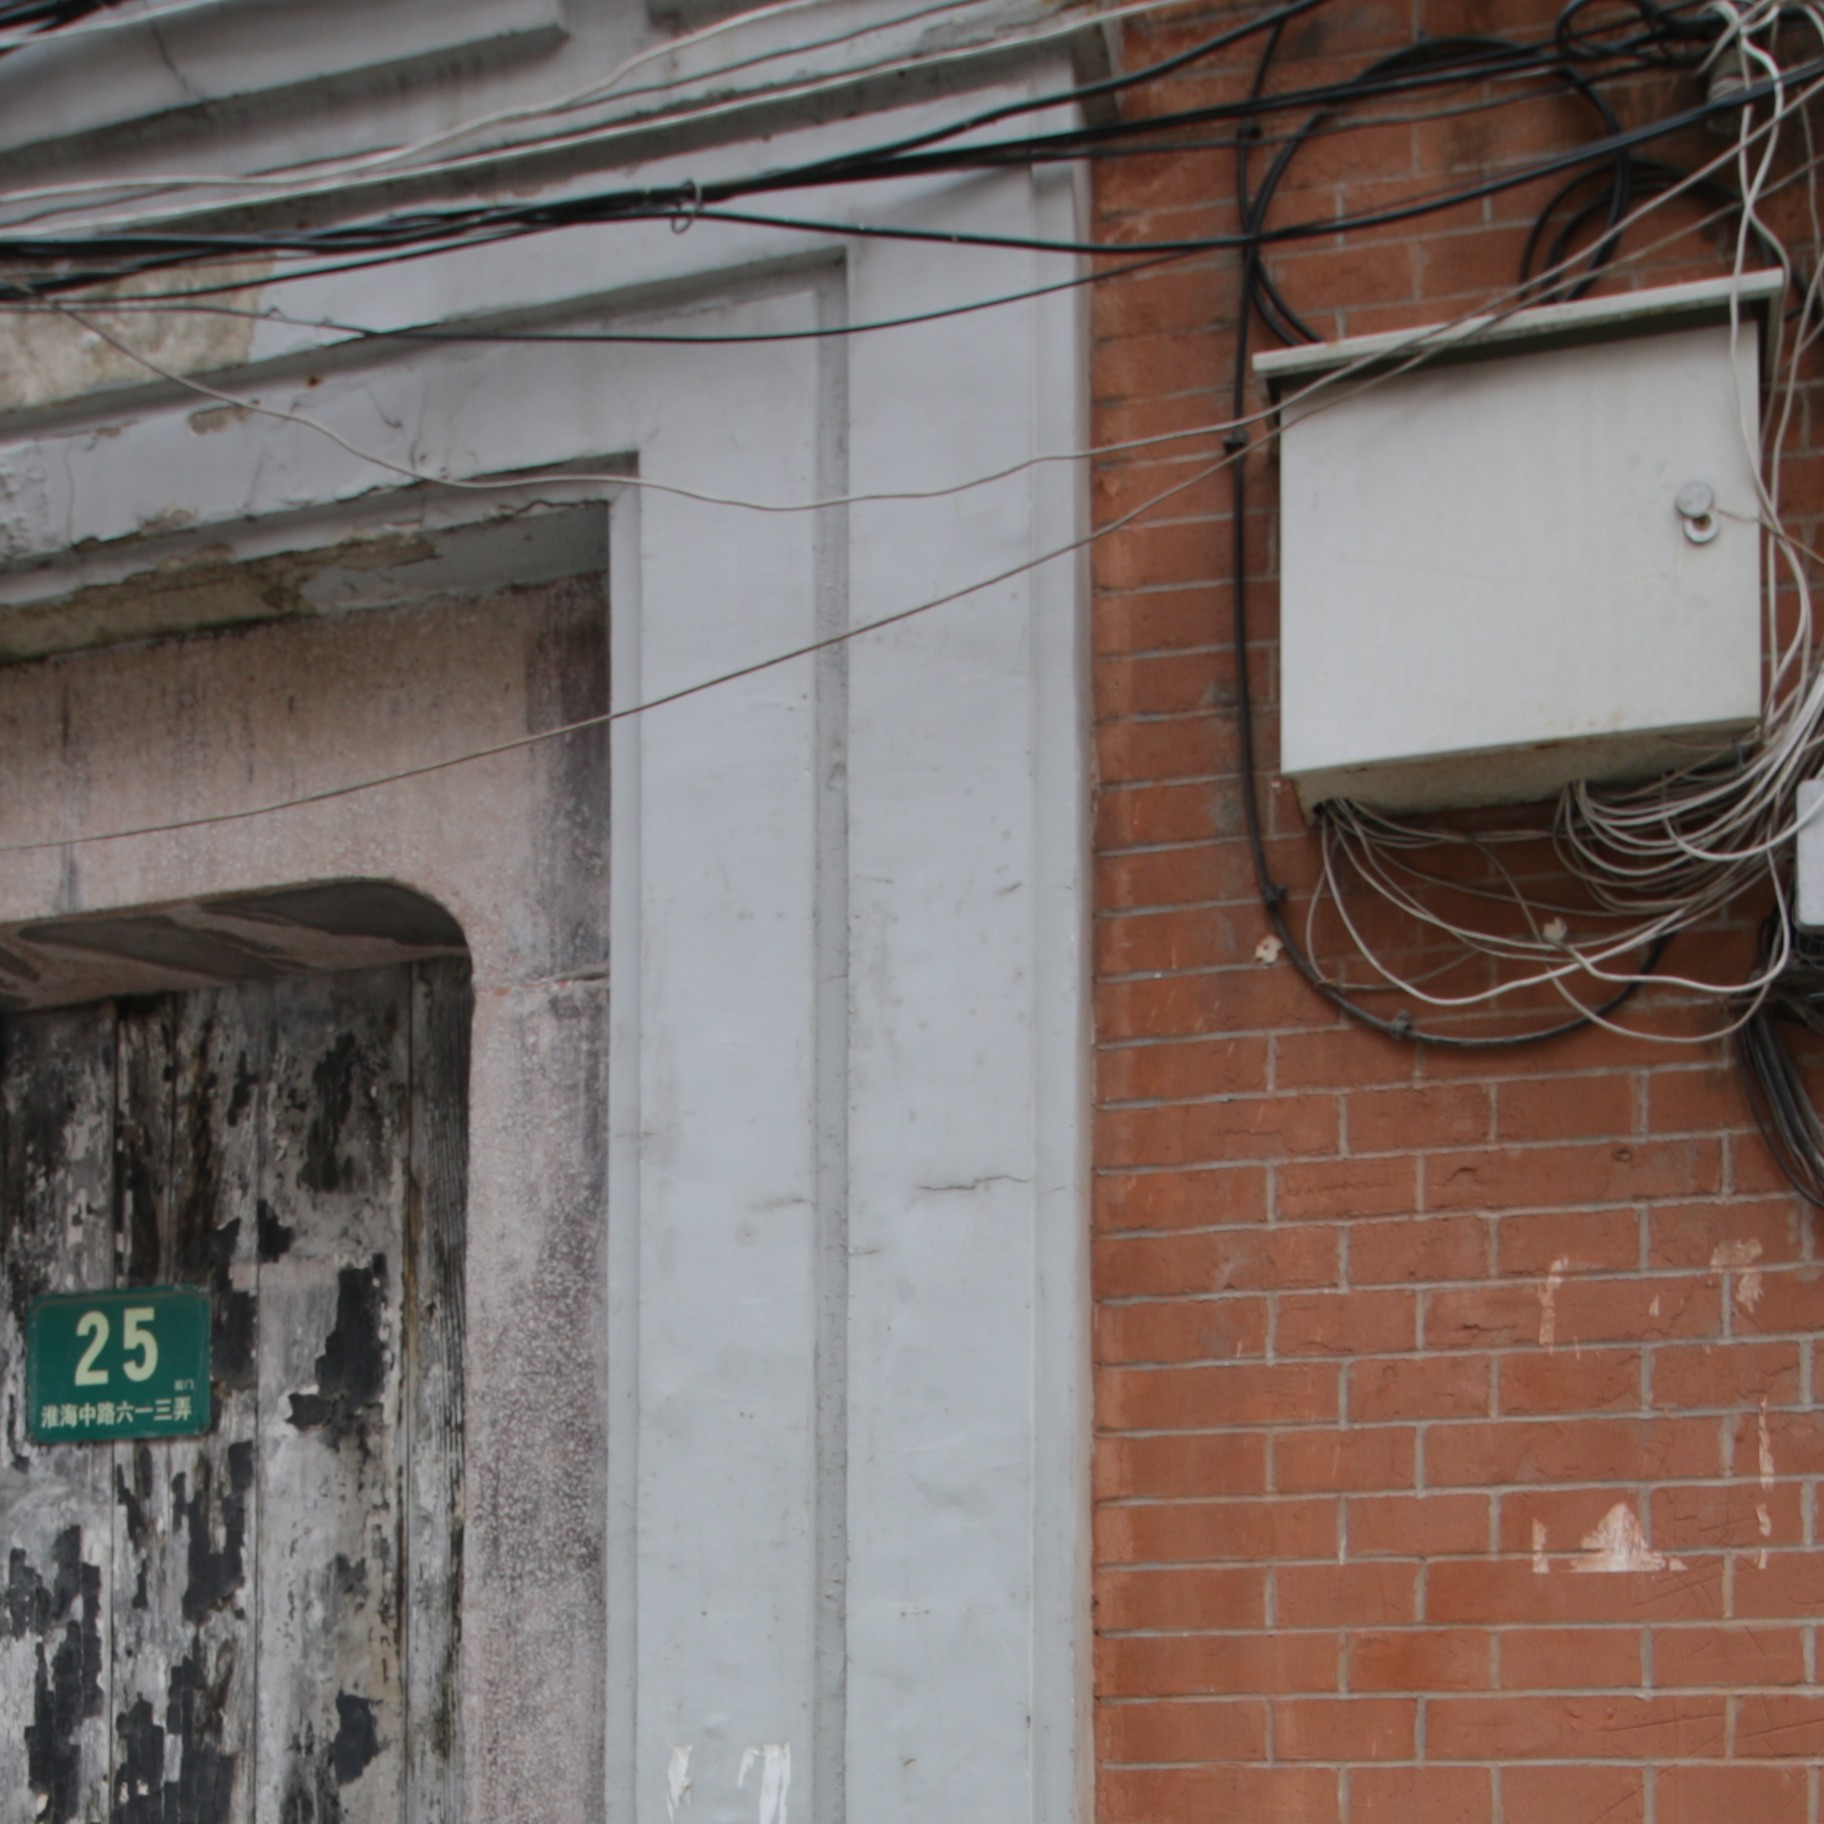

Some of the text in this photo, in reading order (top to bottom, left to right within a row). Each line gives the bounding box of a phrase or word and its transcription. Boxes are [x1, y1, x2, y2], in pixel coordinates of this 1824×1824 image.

[74, 1306, 159, 1387] 25
[40, 1396, 193, 1429] 淮海中路六一三弄
